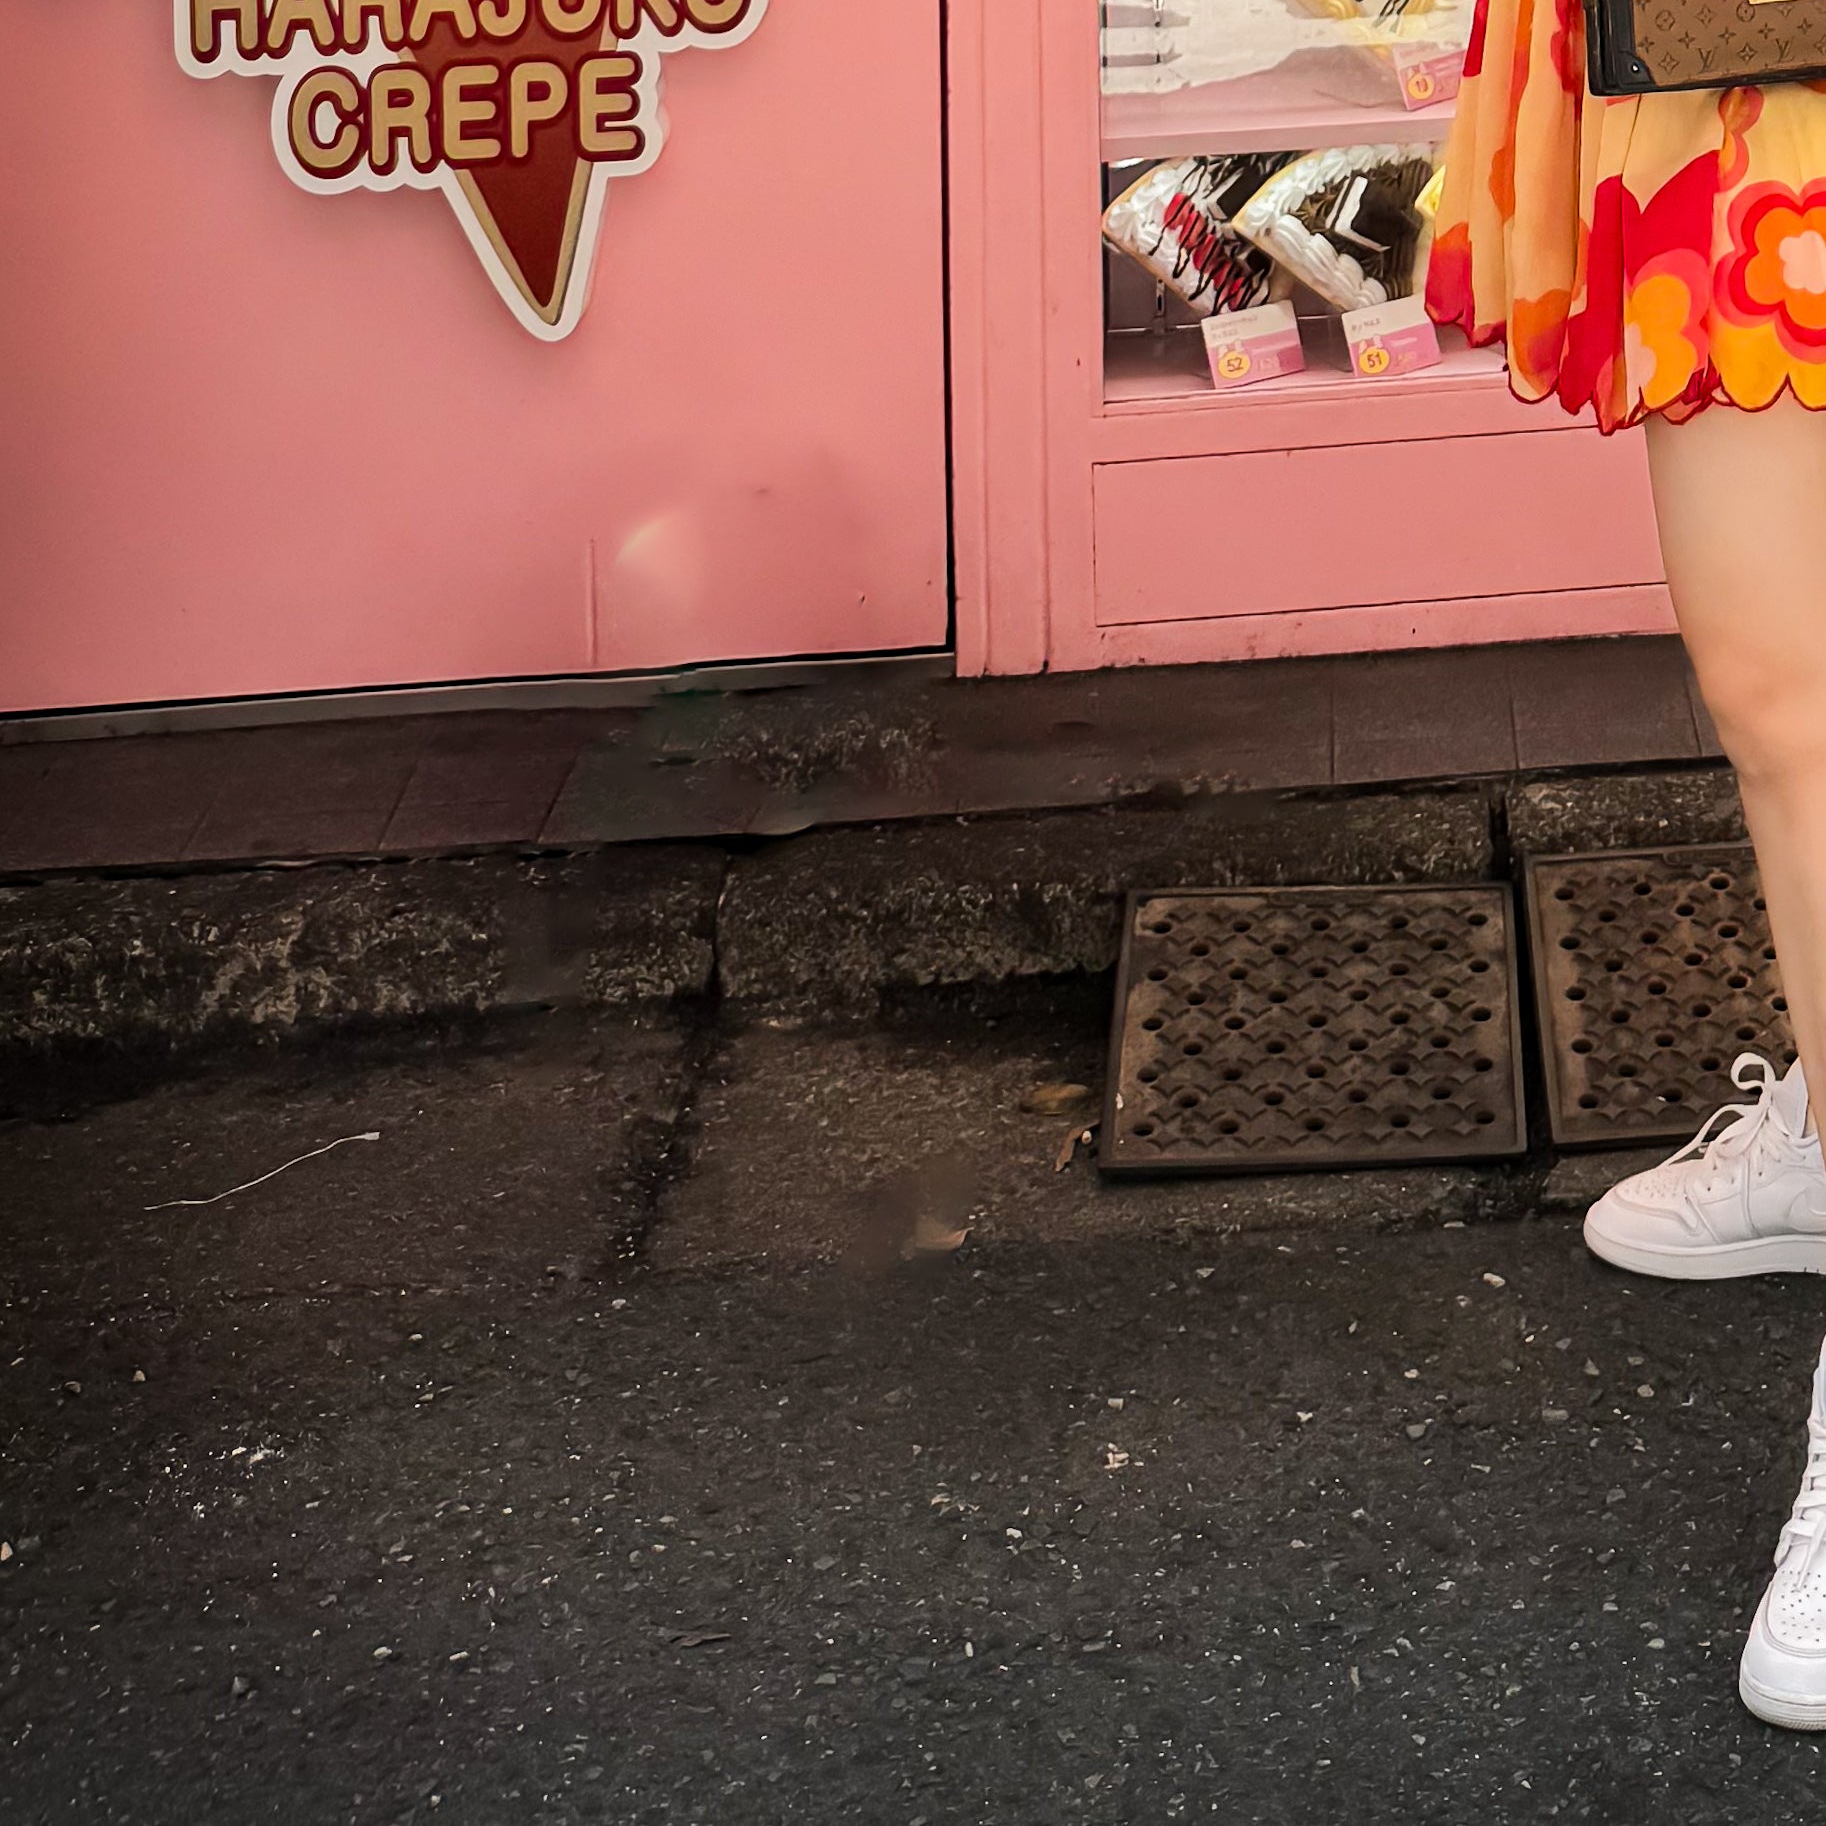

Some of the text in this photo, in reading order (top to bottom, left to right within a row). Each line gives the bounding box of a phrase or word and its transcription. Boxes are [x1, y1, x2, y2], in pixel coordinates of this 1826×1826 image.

[287, 51, 646, 177] CREPE
[1226, 357, 1244, 372] 52
[1367, 353, 1383, 368] 51
